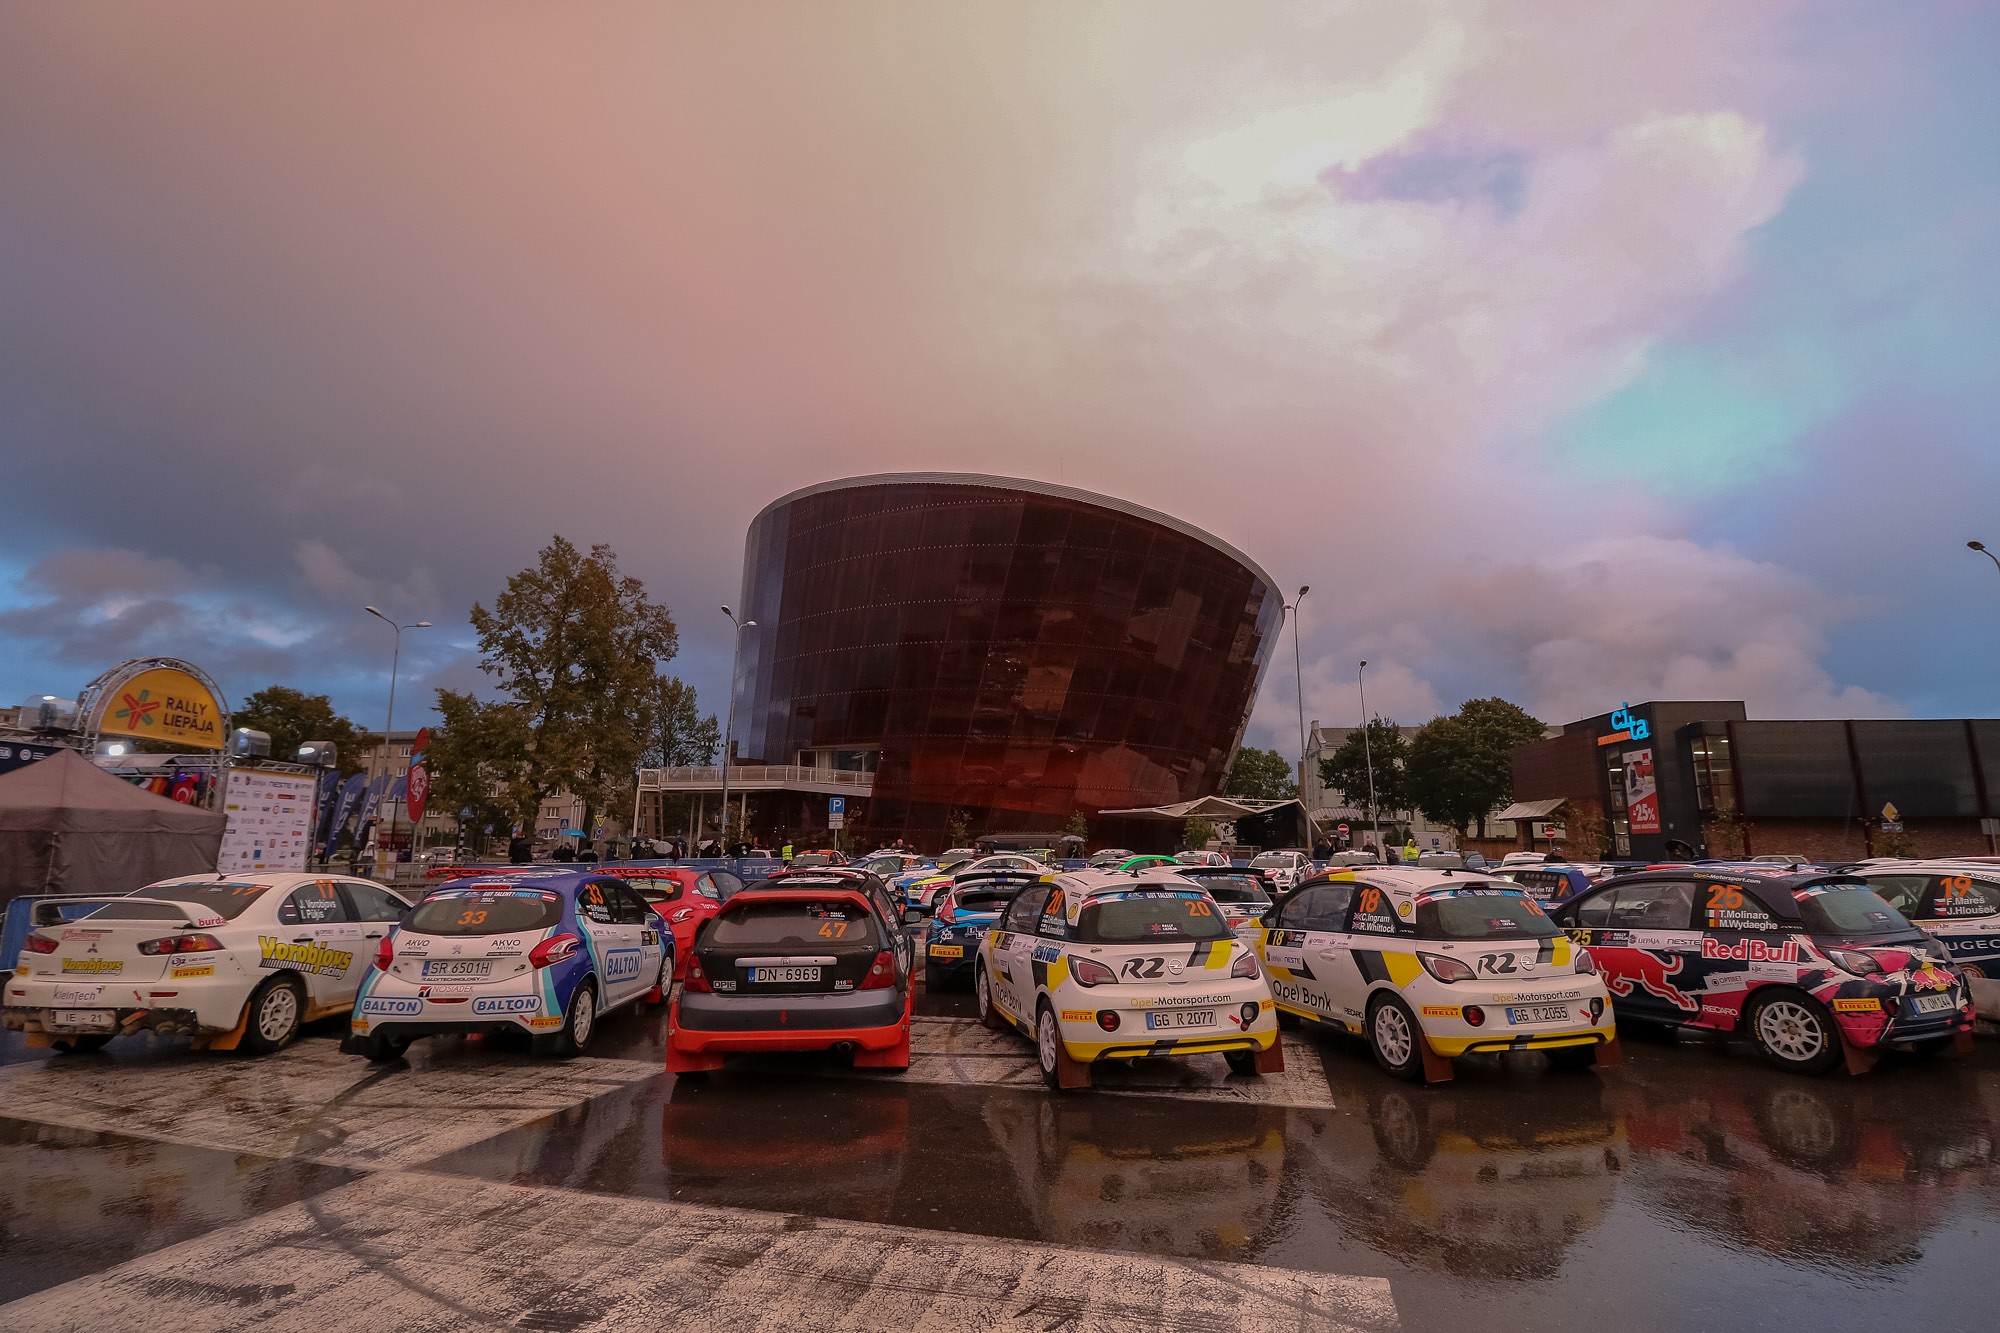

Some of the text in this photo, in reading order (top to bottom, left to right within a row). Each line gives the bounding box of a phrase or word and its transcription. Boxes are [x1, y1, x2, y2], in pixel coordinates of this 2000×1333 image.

[166, 697, 207, 715] RALLY
[163, 713, 214, 733] LIEPĀJA
[833, 799, 841, 811] P
[332, 791, 356, 840] NESTE
[1693, 873, 1761, 884] Opel-Motorsport.com
[231, 887, 261, 896] 17
[315, 879, 335, 898] 17
[585, 883, 604, 904] 33
[1558, 881, 1568, 896] 7
[1940, 876, 1972, 898] 19
[1046, 889, 1065, 914] 20
[1359, 888, 1381, 912] 18
[1706, 884, 1743, 909] 25
[1946, 896, 1985, 905] F.Mareš
[1184, 901, 1211, 917] 20
[1519, 900, 1544, 916] 18
[1719, 910, 1769, 919] T.Molinaro
[1946, 905, 1997, 915] J.Hloušek
[458, 911, 487, 924] 33
[1361, 913, 1390, 924] C.Ingram
[818, 922, 847, 938] 47
[1360, 922, 1396, 933] R.Whittock
[1719, 920, 1778, 931] M.Wydaeghe
[1272, 930, 1284, 946] 18
[1573, 930, 1592, 945] 25
[258, 935, 353, 974] Vorobjovs
[931, 946, 960, 956] PIRELLI
[62, 958, 124, 975] Vorobjovs
[430, 962, 490, 973] SR 6501H
[606, 955, 640, 976] BALTON
[1120, 957, 1165, 979] R2
[1477, 952, 1518, 975] R2
[174, 967, 210, 977] PIRELLI
[320, 967, 346, 980] racing
[714, 981, 736, 989] OPIE
[1719, 975, 1742, 984] OPTIBET
[1130, 994, 1231, 1007] Opel-Motorsport.com
[1272, 980, 1332, 1011] Opel Bank
[1492, 990, 1581, 1003] Opel-Motorsport.com
[363, 1001, 417, 1012] BALTON
[477, 998, 537, 1010] BALTON
[1702, 1005, 1738, 1016] RECARO
[1838, 1000, 1876, 1009] PIRELLI
[91, 1014, 102, 1022] 21
[1062, 1010, 1093, 1021] PIRELLI
[1423, 1007, 1459, 1016] PIRELLI
[1514, 1007, 1567, 1021] GG R 2055
[531, 1016, 561, 1027] PIRELLI
[1154, 1011, 1214, 1026] GG R 2077
